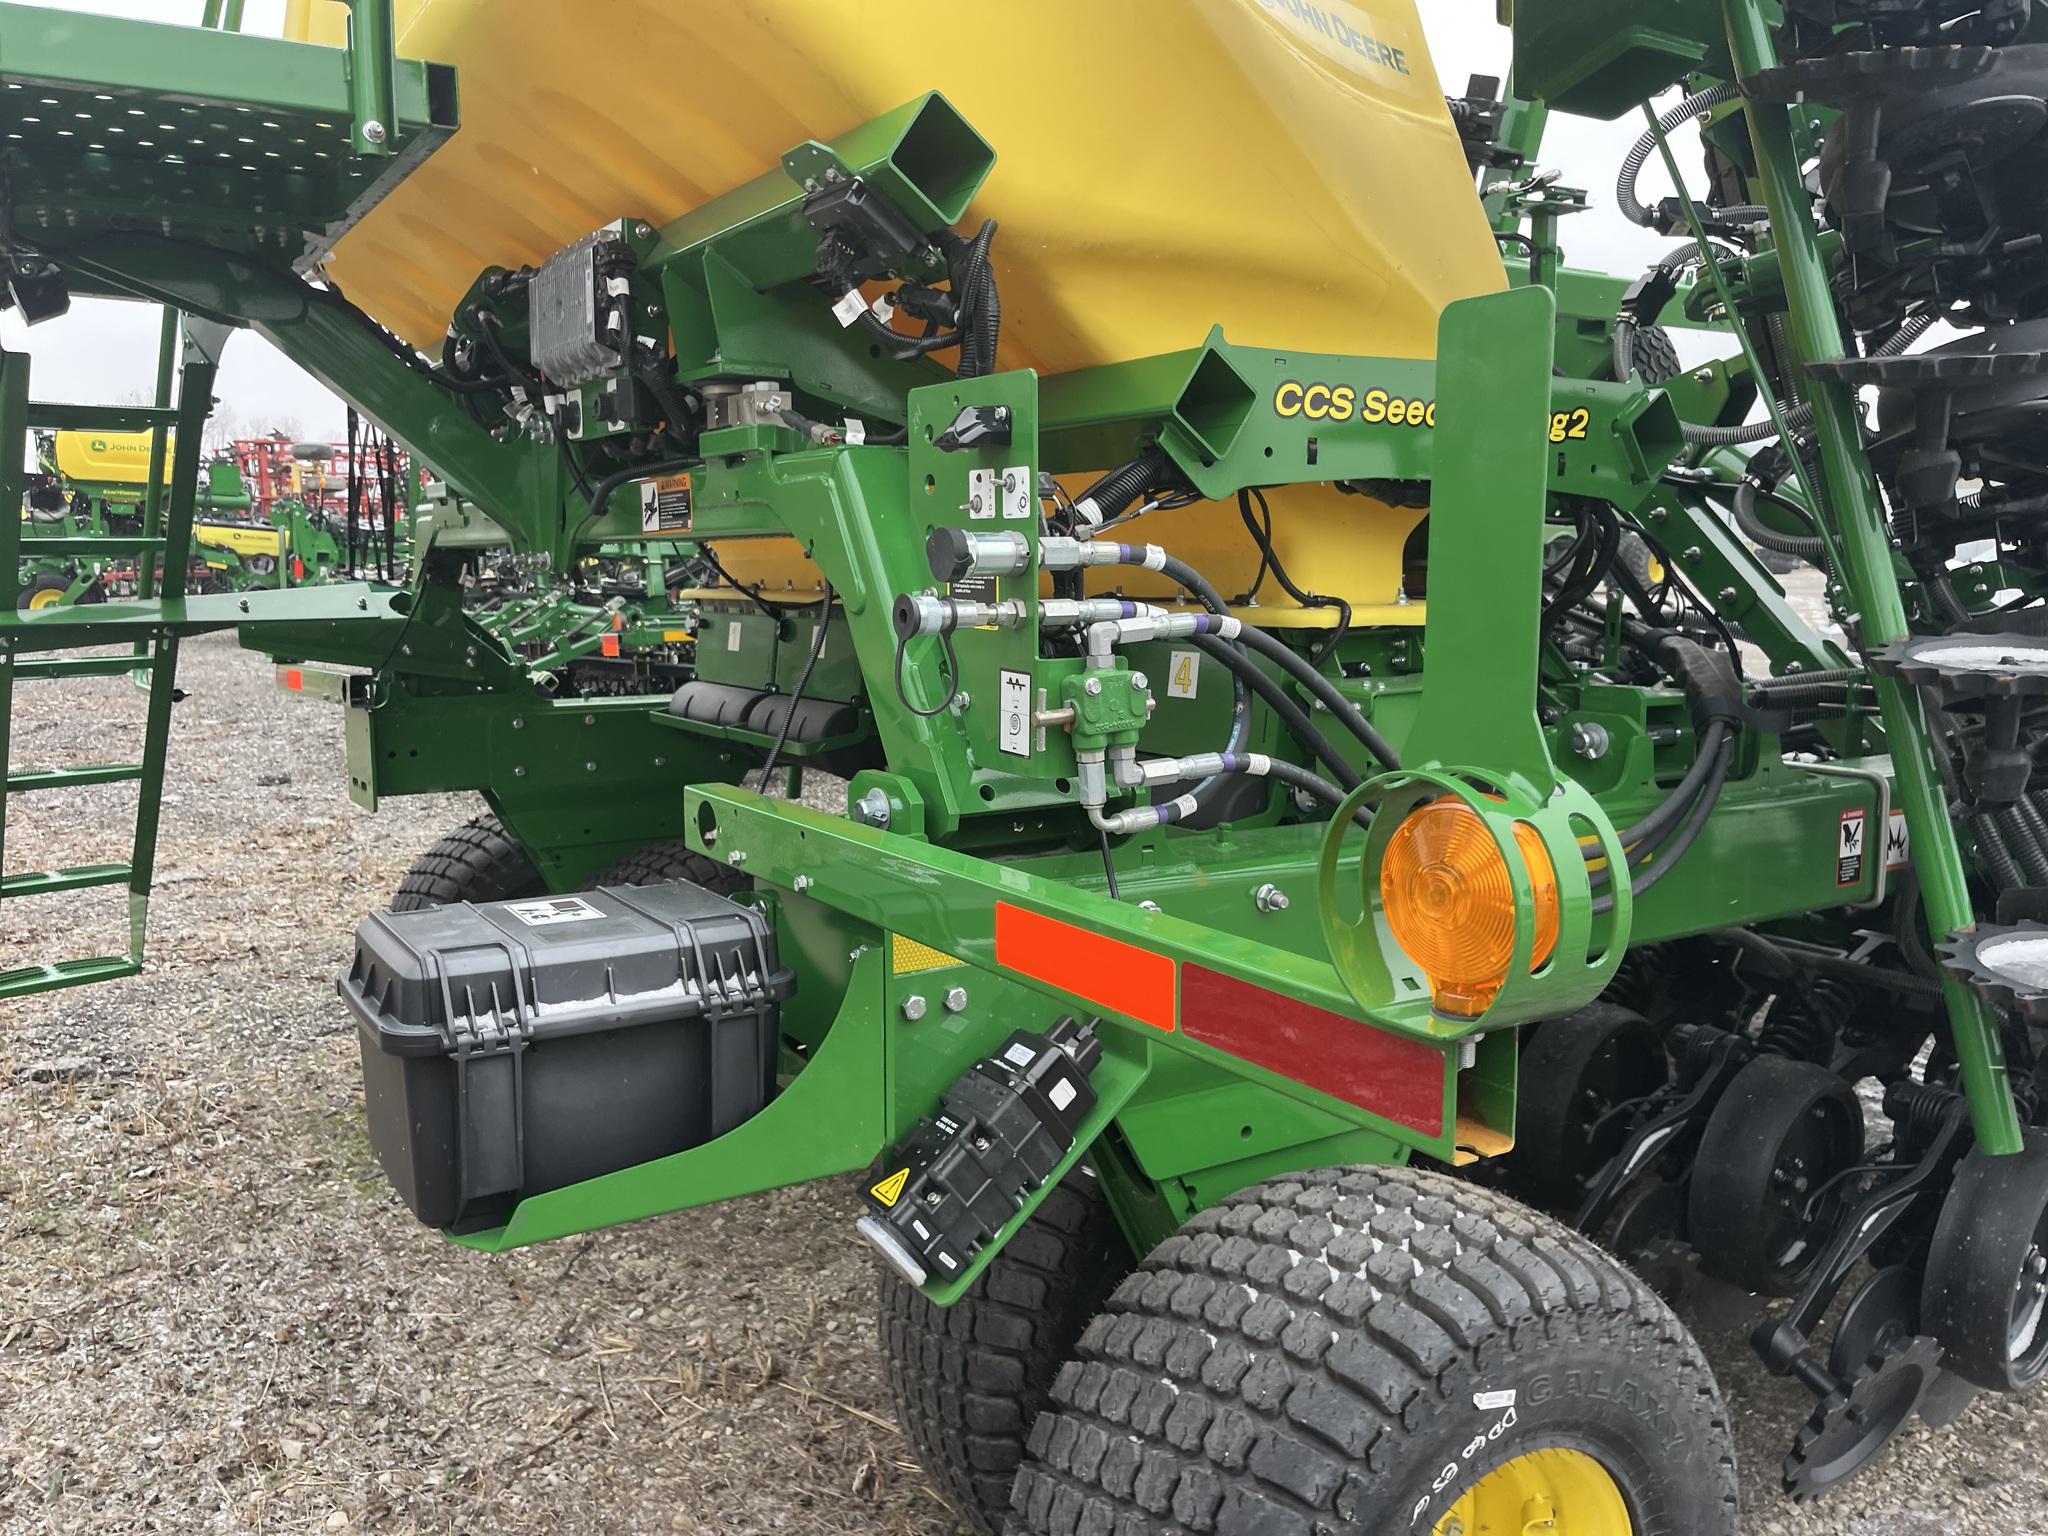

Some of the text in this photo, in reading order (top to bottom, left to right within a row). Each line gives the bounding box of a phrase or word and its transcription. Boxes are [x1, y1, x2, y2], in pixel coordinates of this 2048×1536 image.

[1329, 12, 1410, 75] DEERE
[1274, 382, 1355, 420] CCS
[109, 443, 137, 452] JOHN
[1174, 656, 1192, 693] 4
[1847, 810, 1864, 819] DANGER
[1525, 1369, 1687, 1451] GALAXY
